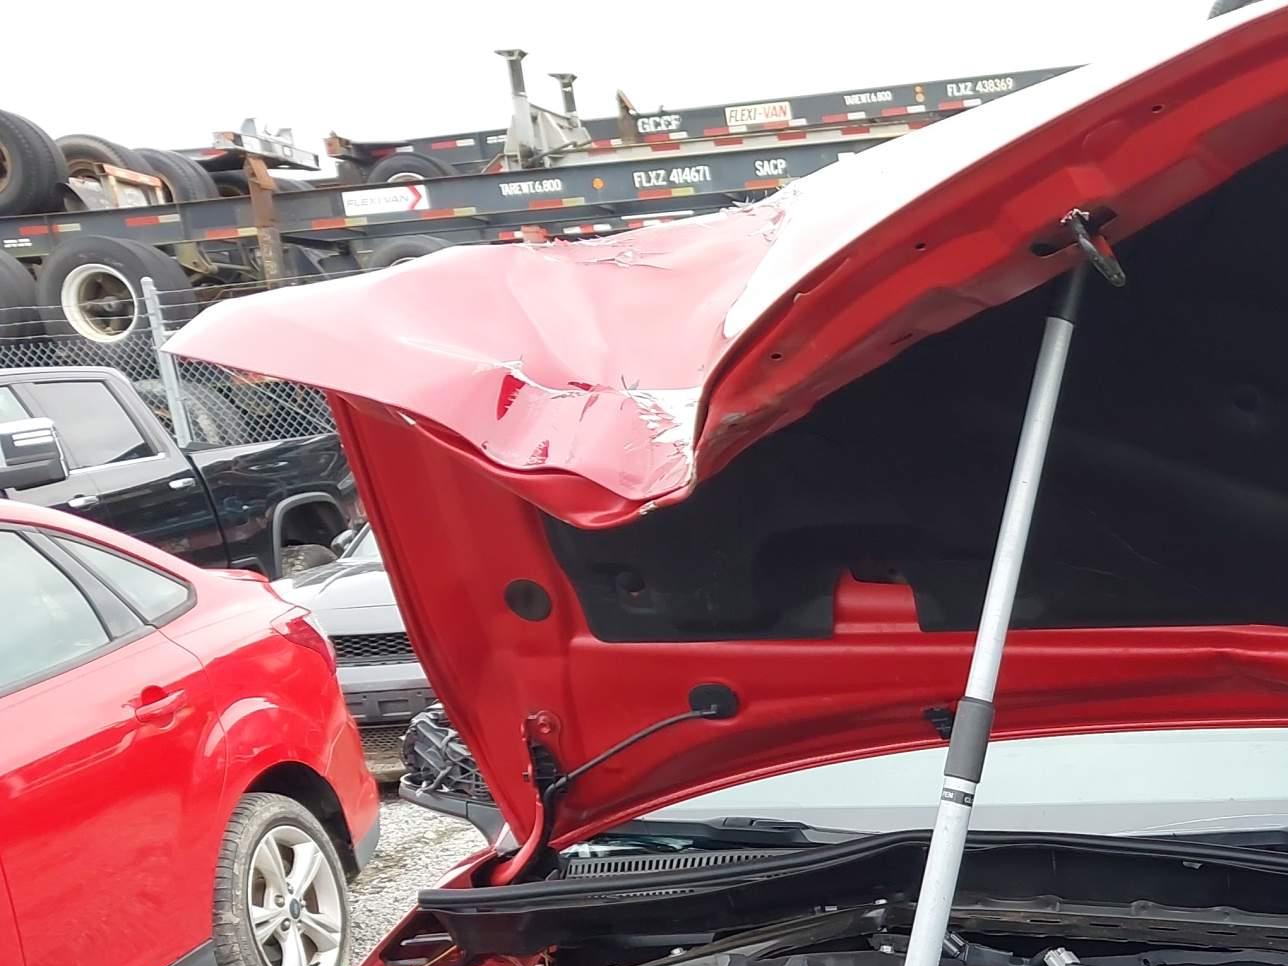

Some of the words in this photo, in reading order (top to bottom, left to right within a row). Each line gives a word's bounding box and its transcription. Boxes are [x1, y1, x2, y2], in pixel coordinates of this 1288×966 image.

[946, 81, 975, 97] FLXZ
[976, 77, 1013, 94] 438369
[729, 104, 788, 123] FLEXI-VAN
[633, 168, 667, 188] FLXZ
[669, 165, 711, 185] 414671
[755, 158, 787, 177] SACP
